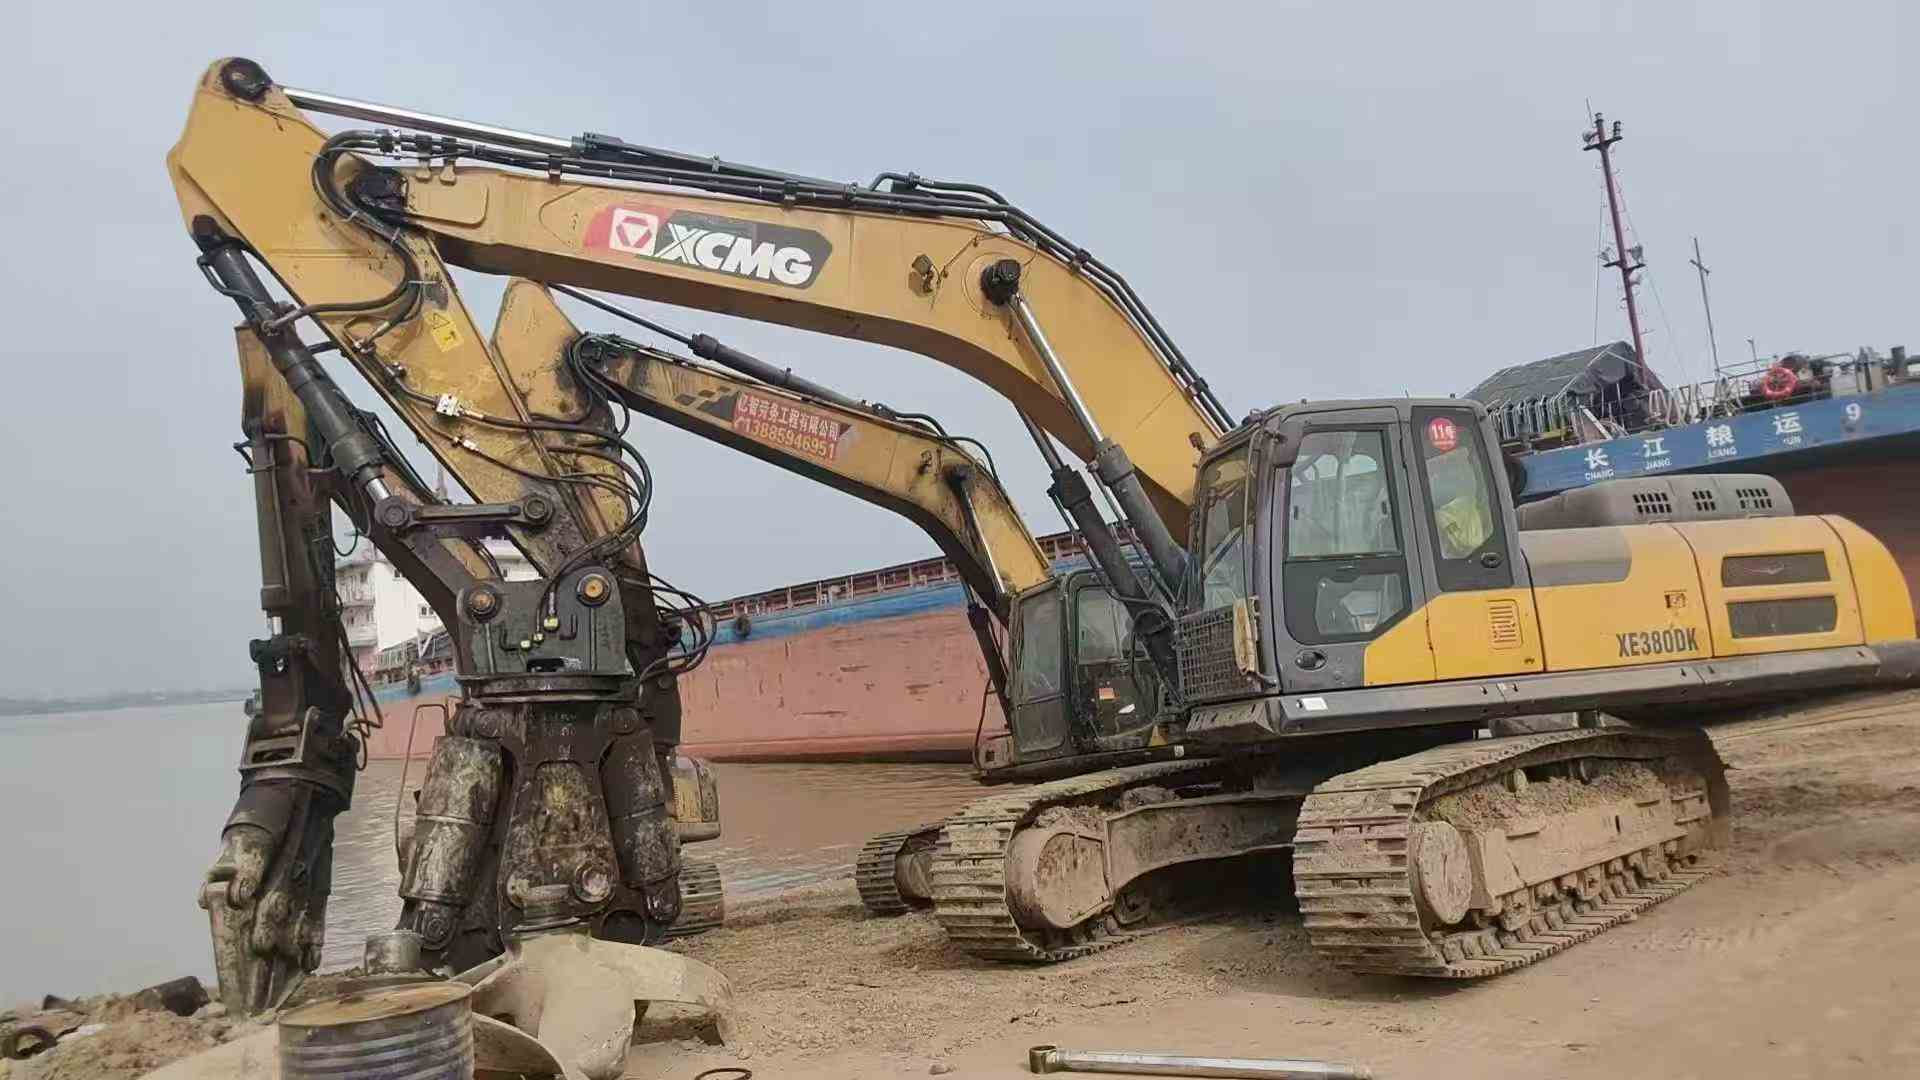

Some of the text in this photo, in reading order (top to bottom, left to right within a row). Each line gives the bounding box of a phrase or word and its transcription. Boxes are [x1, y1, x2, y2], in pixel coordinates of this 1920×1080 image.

[653, 222, 813, 285] XCMG
[1846, 402, 1861, 420] 9
[1585, 469, 1614, 480] CHANG
[1645, 458, 1671, 470] JIANG
[1708, 447, 1737, 458] LIANG
[1615, 627, 1699, 658] XE380DK
